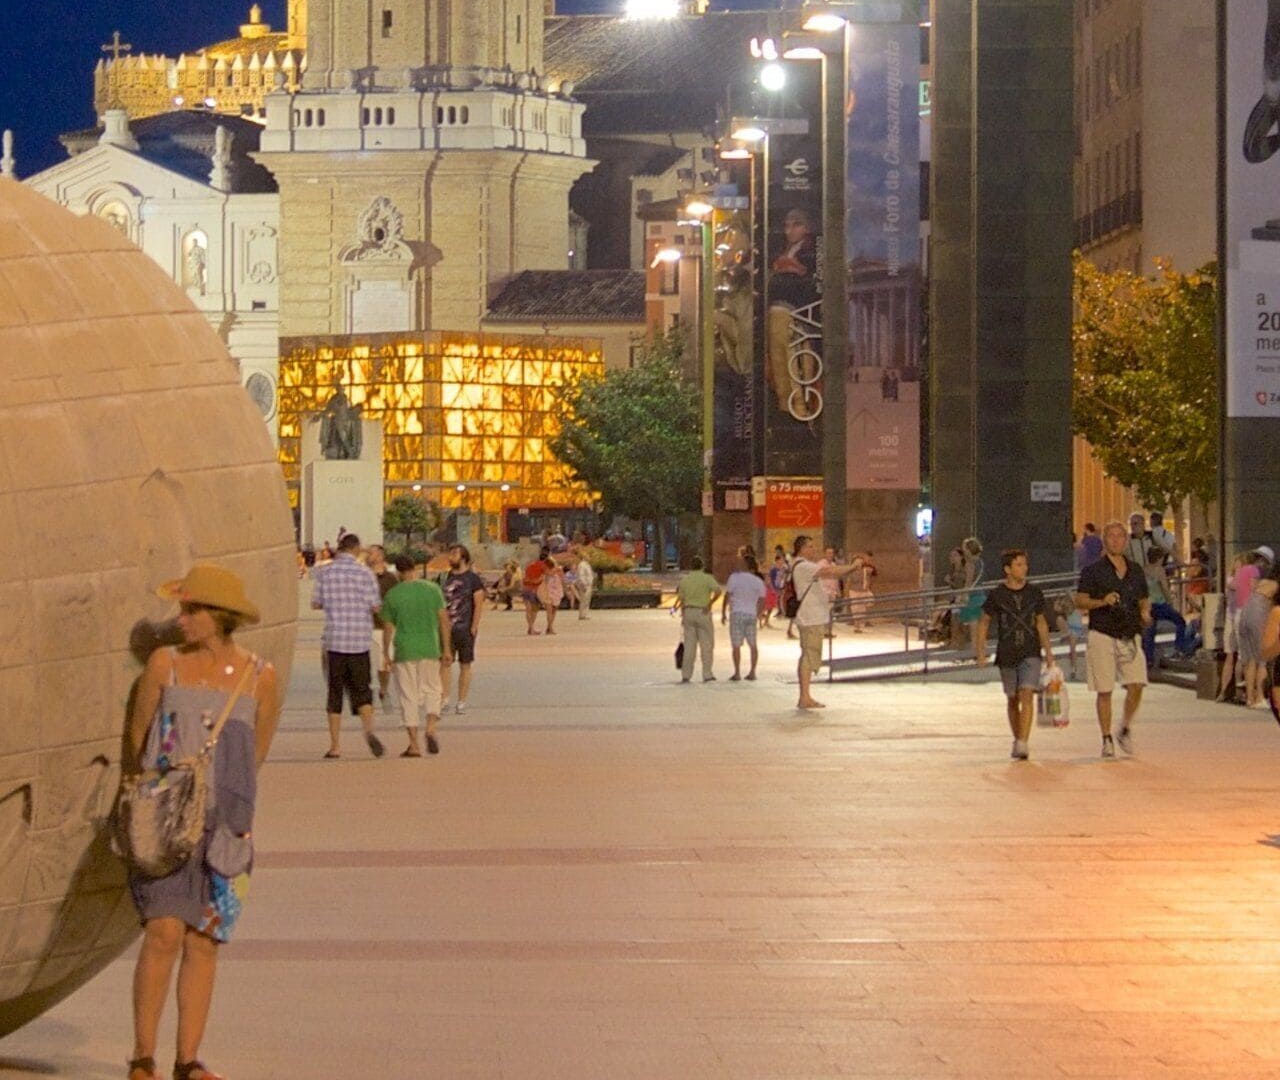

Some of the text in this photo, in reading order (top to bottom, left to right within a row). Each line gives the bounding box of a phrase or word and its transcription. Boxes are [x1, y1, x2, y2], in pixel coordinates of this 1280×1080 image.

[884, 169, 900, 190] de
[883, 196, 900, 232] Foro
[1256, 293, 1266, 306] a
[788, 299, 824, 421] GOYA
[878, 435, 899, 446] 100
[778, 483, 791, 492] 75
[792, 484, 824, 492] metros
